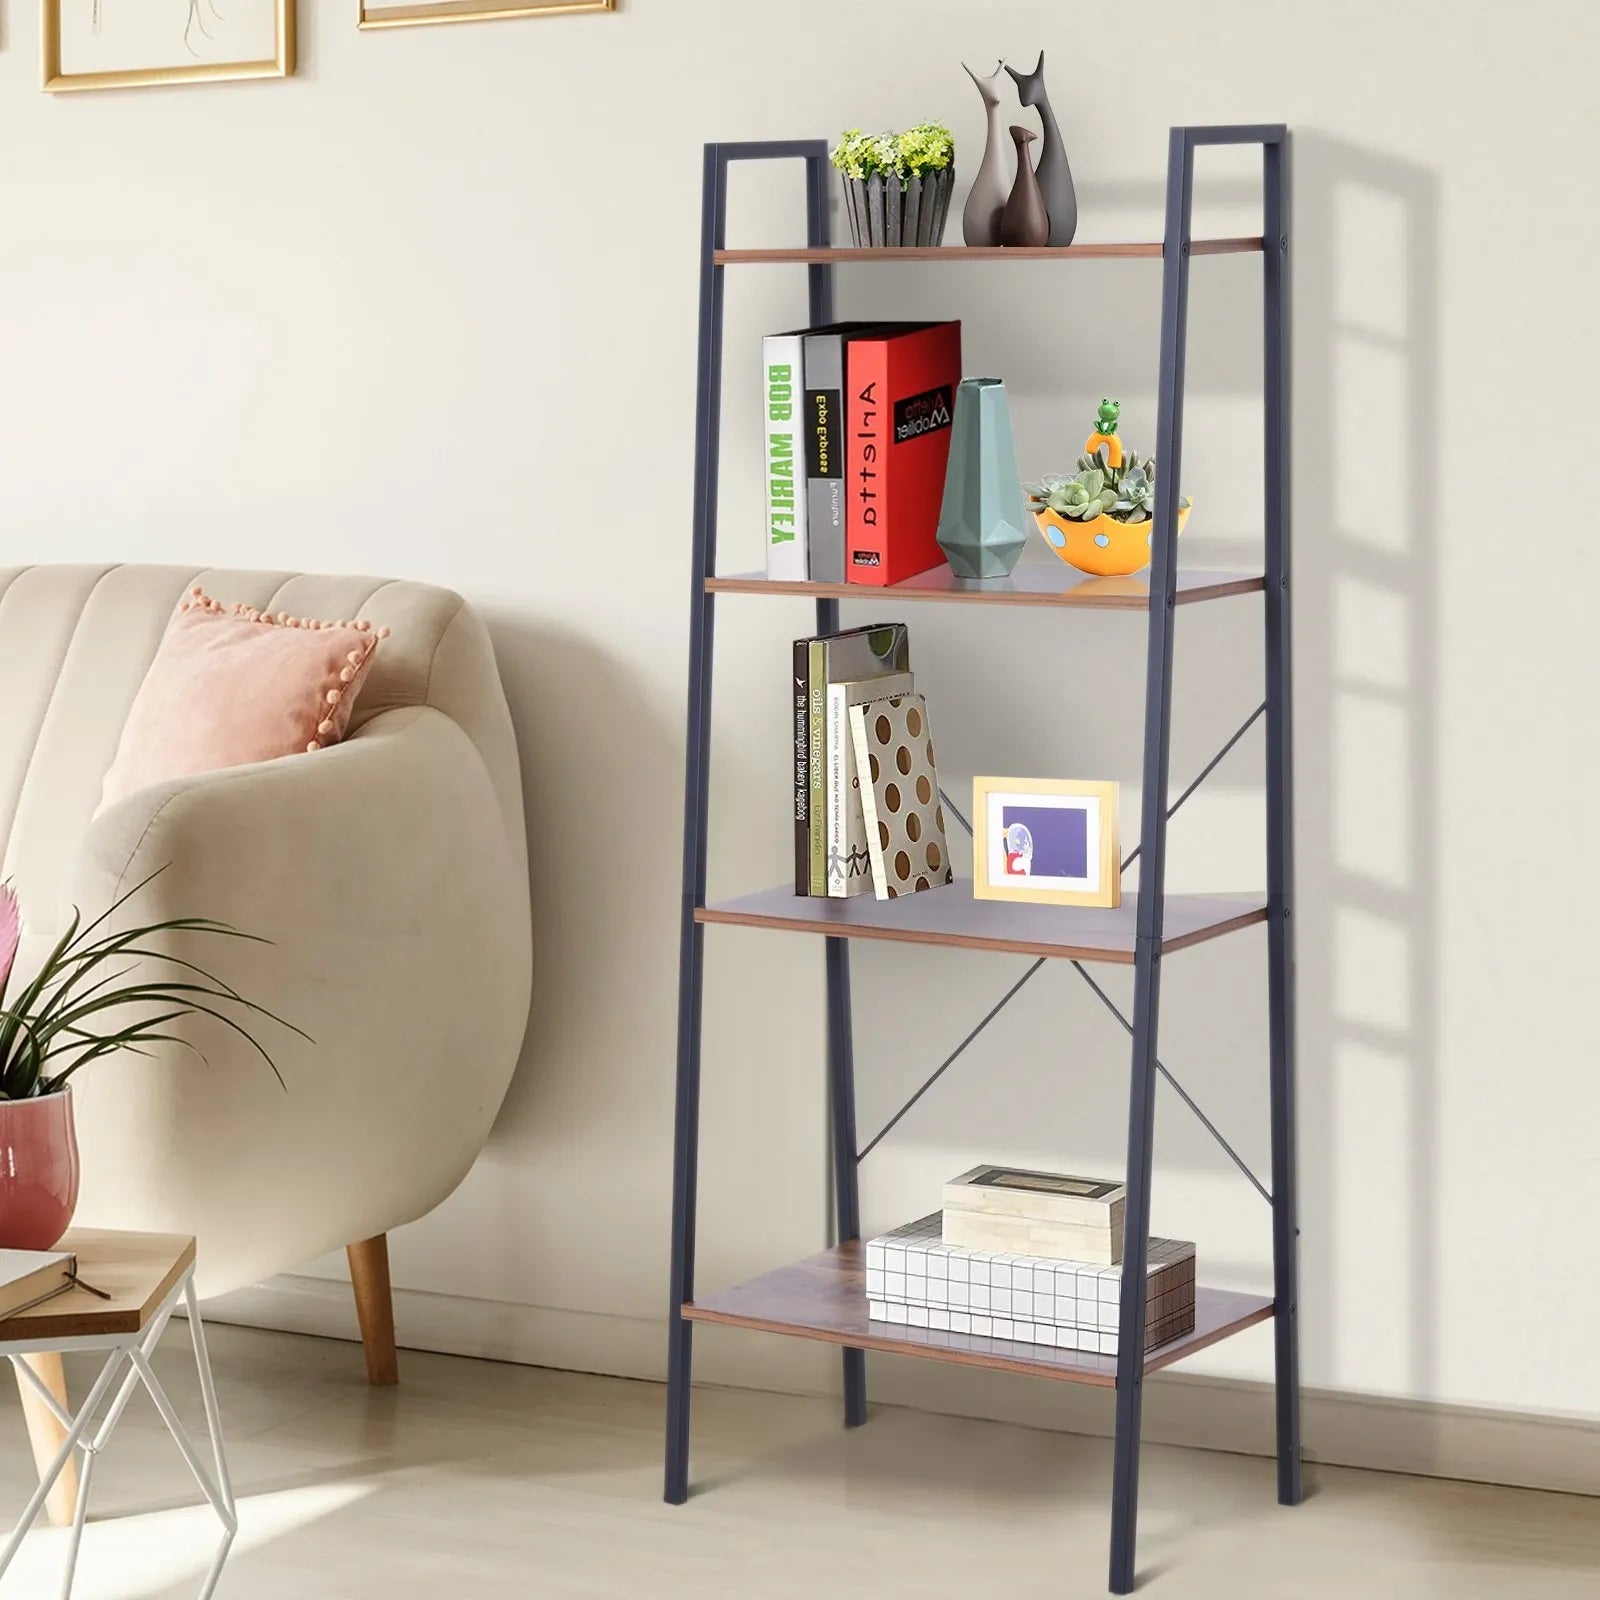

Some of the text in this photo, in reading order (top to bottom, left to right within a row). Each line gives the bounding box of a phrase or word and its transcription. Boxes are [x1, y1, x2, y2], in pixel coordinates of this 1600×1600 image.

[796, 695, 806, 708] the
[794, 710, 807, 759] hummingbird
[810, 689, 822, 789] oils & vinegars
[794, 761, 807, 787] bakery
